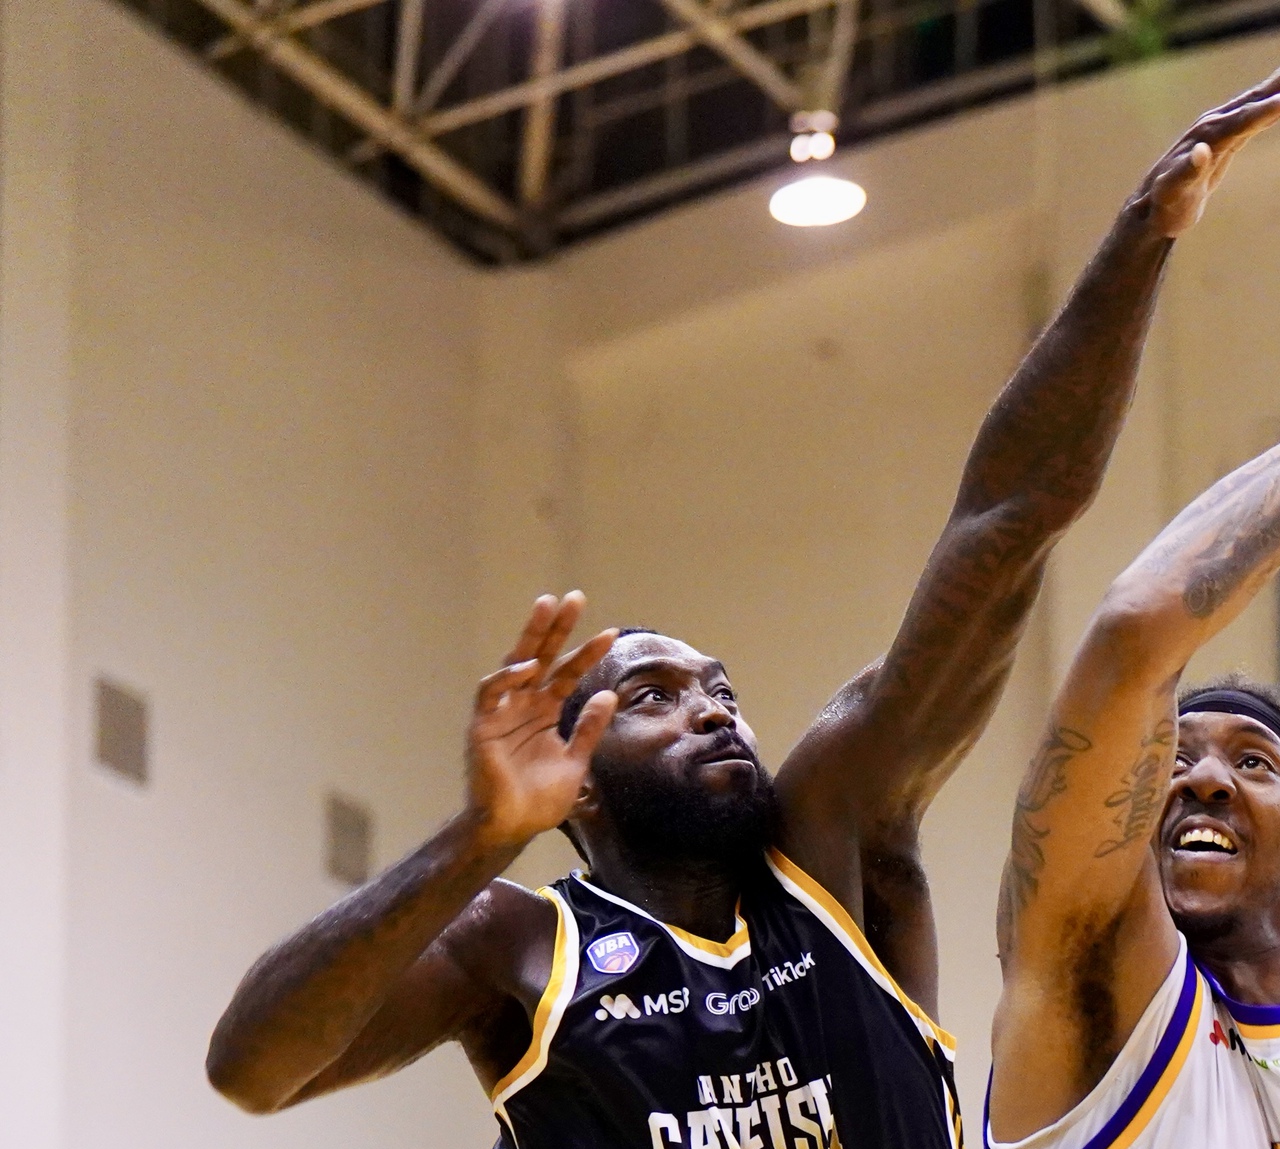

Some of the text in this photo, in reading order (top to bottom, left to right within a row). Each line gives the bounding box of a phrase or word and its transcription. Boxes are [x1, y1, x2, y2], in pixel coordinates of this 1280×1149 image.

[594, 935, 631, 958] VBA
[762, 952, 816, 991] TikTok
[696, 1074, 744, 1105] AN
